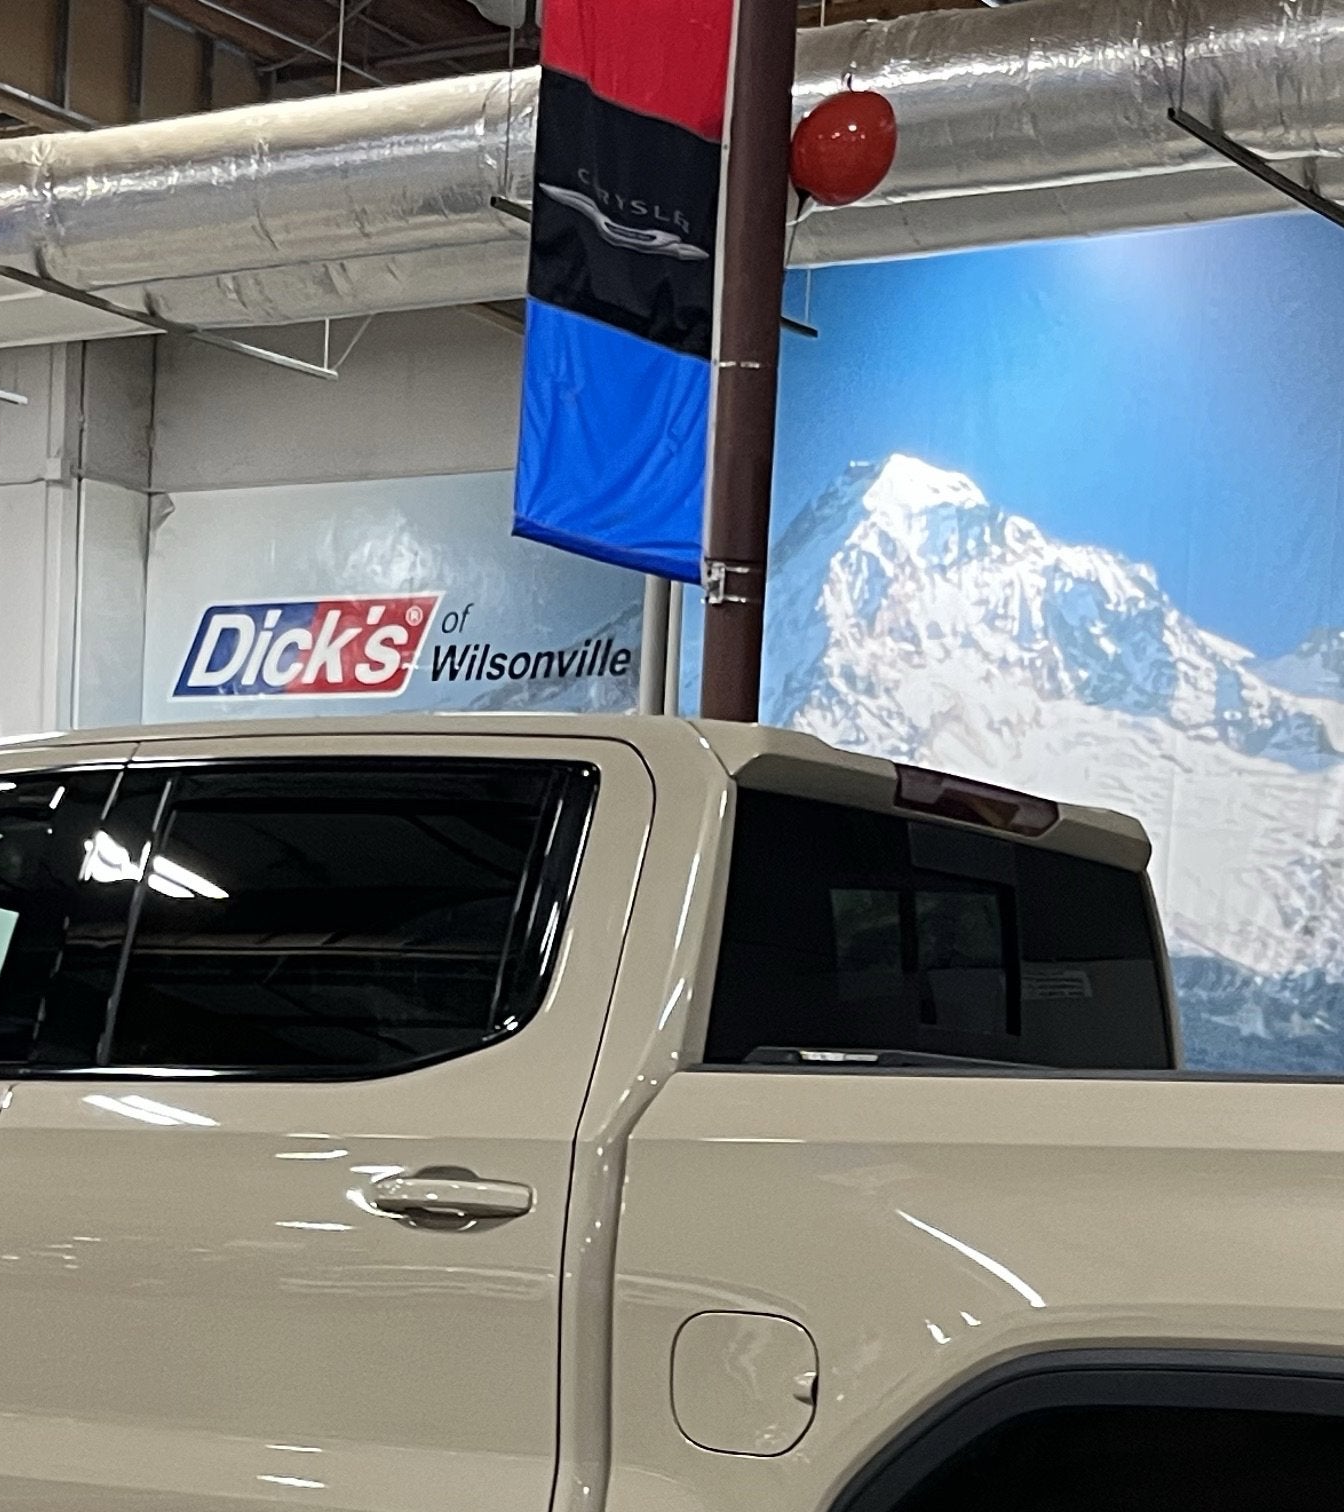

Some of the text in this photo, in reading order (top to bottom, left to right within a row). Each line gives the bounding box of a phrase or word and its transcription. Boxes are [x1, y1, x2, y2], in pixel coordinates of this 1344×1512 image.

[577, 168, 690, 234] CRYSLE
[441, 602, 475, 634] of
[187, 605, 410, 688] Dick's
[431, 638, 632, 683] Wilsonville
